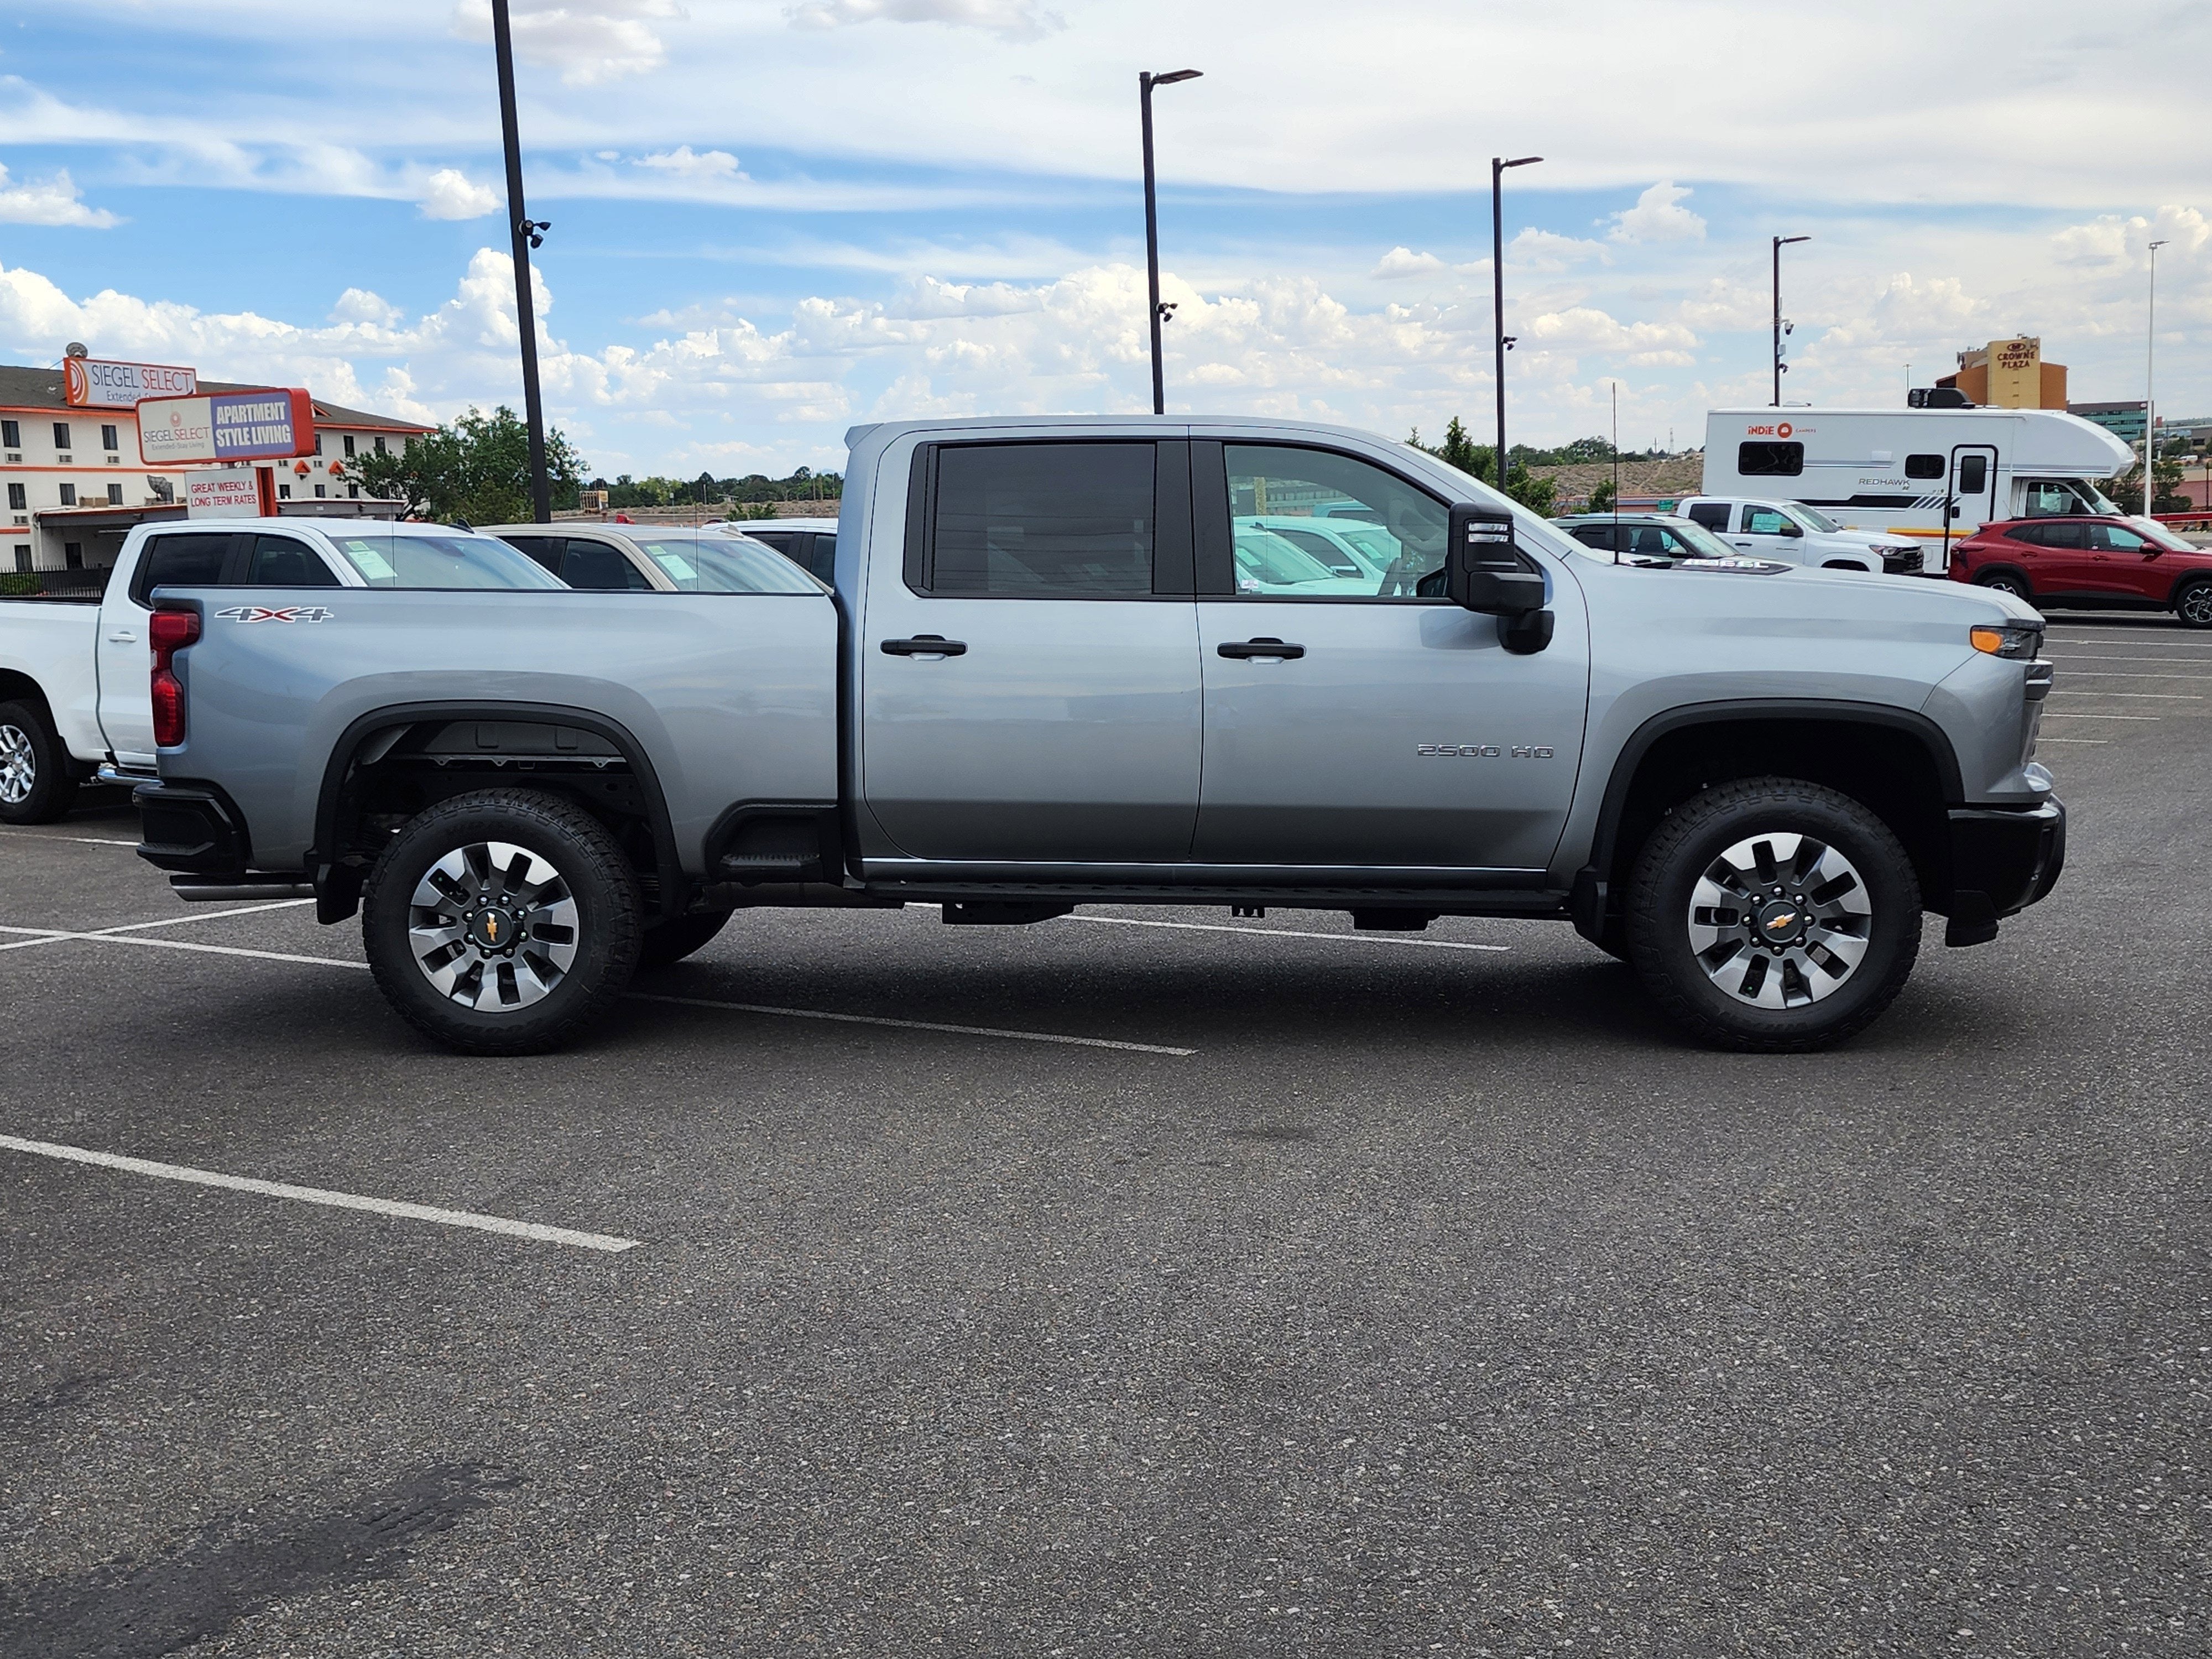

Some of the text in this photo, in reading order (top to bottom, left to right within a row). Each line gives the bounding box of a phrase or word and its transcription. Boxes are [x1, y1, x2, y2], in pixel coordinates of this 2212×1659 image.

[1997, 351, 2035, 361] CROWNE
[2002, 360, 2030, 369] PLAZA
[92, 364, 191, 392] SIEGEL SELECT
[216, 402, 285, 425] APARTMENT
[144, 427, 210, 443] SIEGEL SELECT
[216, 425, 291, 447] STYLE LIVING
[191, 481, 254, 493] GREAT WEEKLY &
[191, 494, 257, 507] LONG TERM RATES
[1417, 743, 1554, 758] 2500 HD
